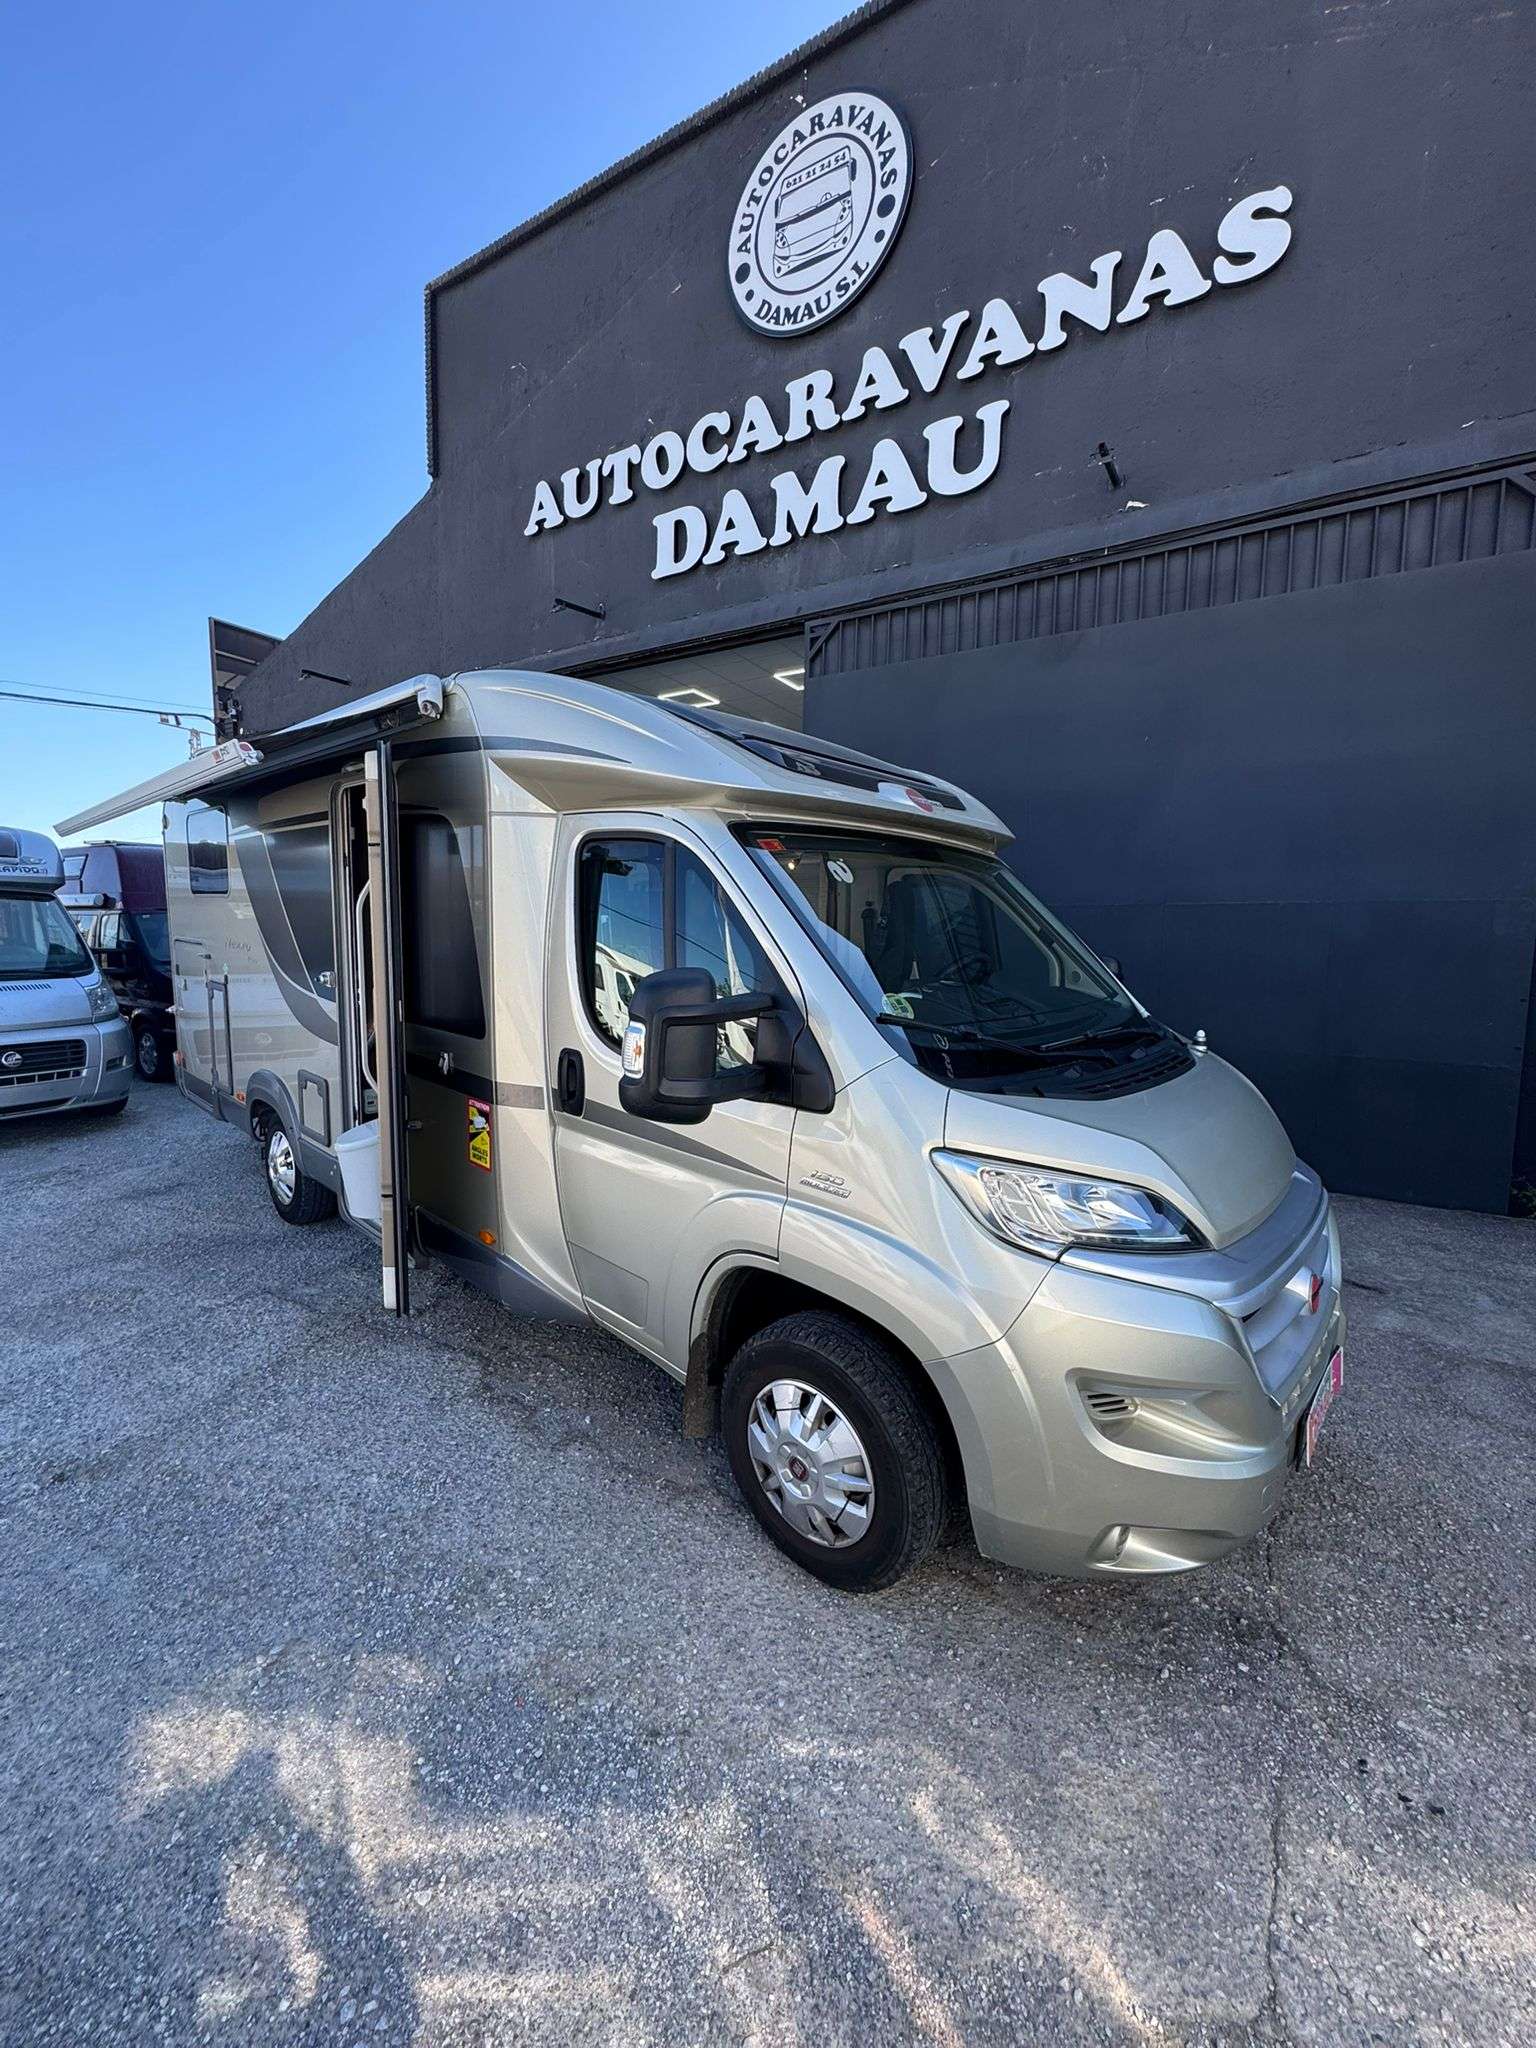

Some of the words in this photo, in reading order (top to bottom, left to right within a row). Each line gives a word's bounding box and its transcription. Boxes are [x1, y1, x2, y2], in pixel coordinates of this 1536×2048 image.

[736, 104, 897, 255] AUTOCARAVANAS
[786, 175, 802, 189] 621
[805, 167, 816, 180] 21
[523, 186, 1294, 538] AUTOCARAVANAS
[755, 291, 831, 326] DAMAU
[650, 399, 1011, 581] DAMAU
